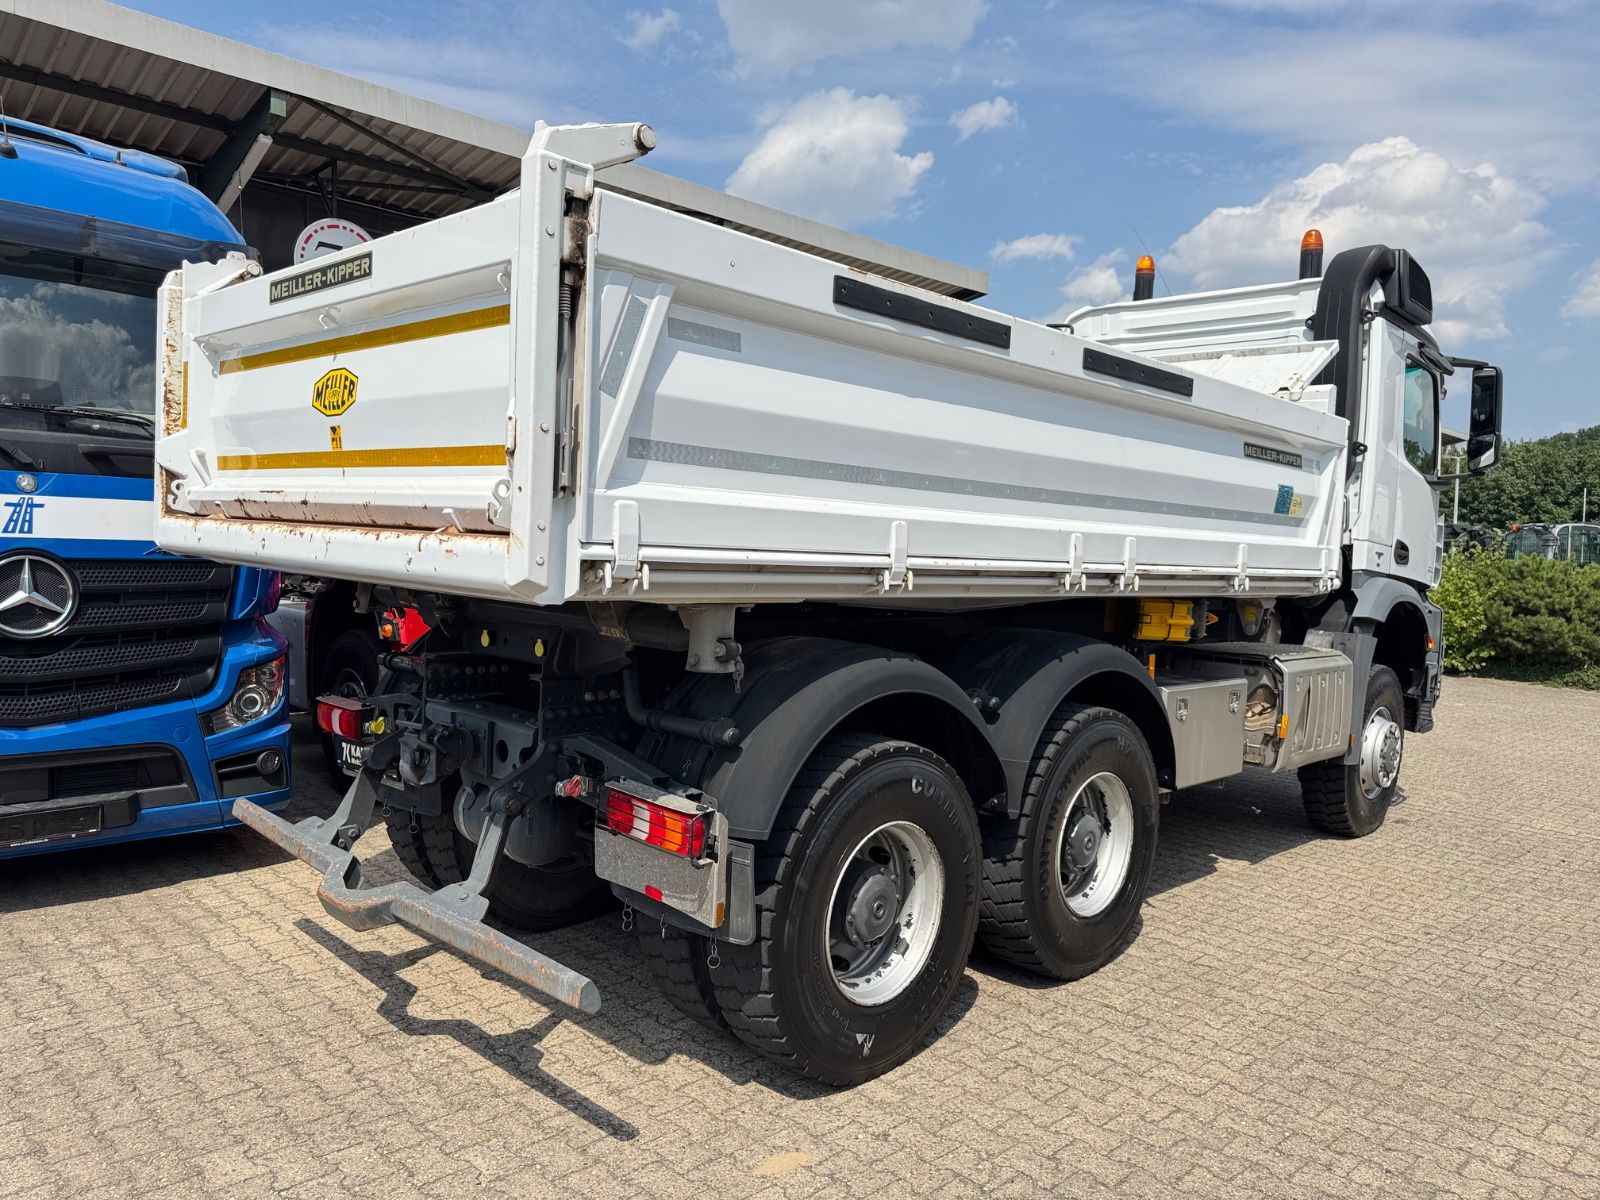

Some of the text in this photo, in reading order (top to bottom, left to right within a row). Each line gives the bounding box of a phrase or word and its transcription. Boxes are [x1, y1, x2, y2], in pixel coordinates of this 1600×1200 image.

[271, 257, 370, 300] MEILLER-KIPPER
[315, 373, 356, 411] MEILLER
[1244, 444, 1301, 466] MEILLER-KIPPER
